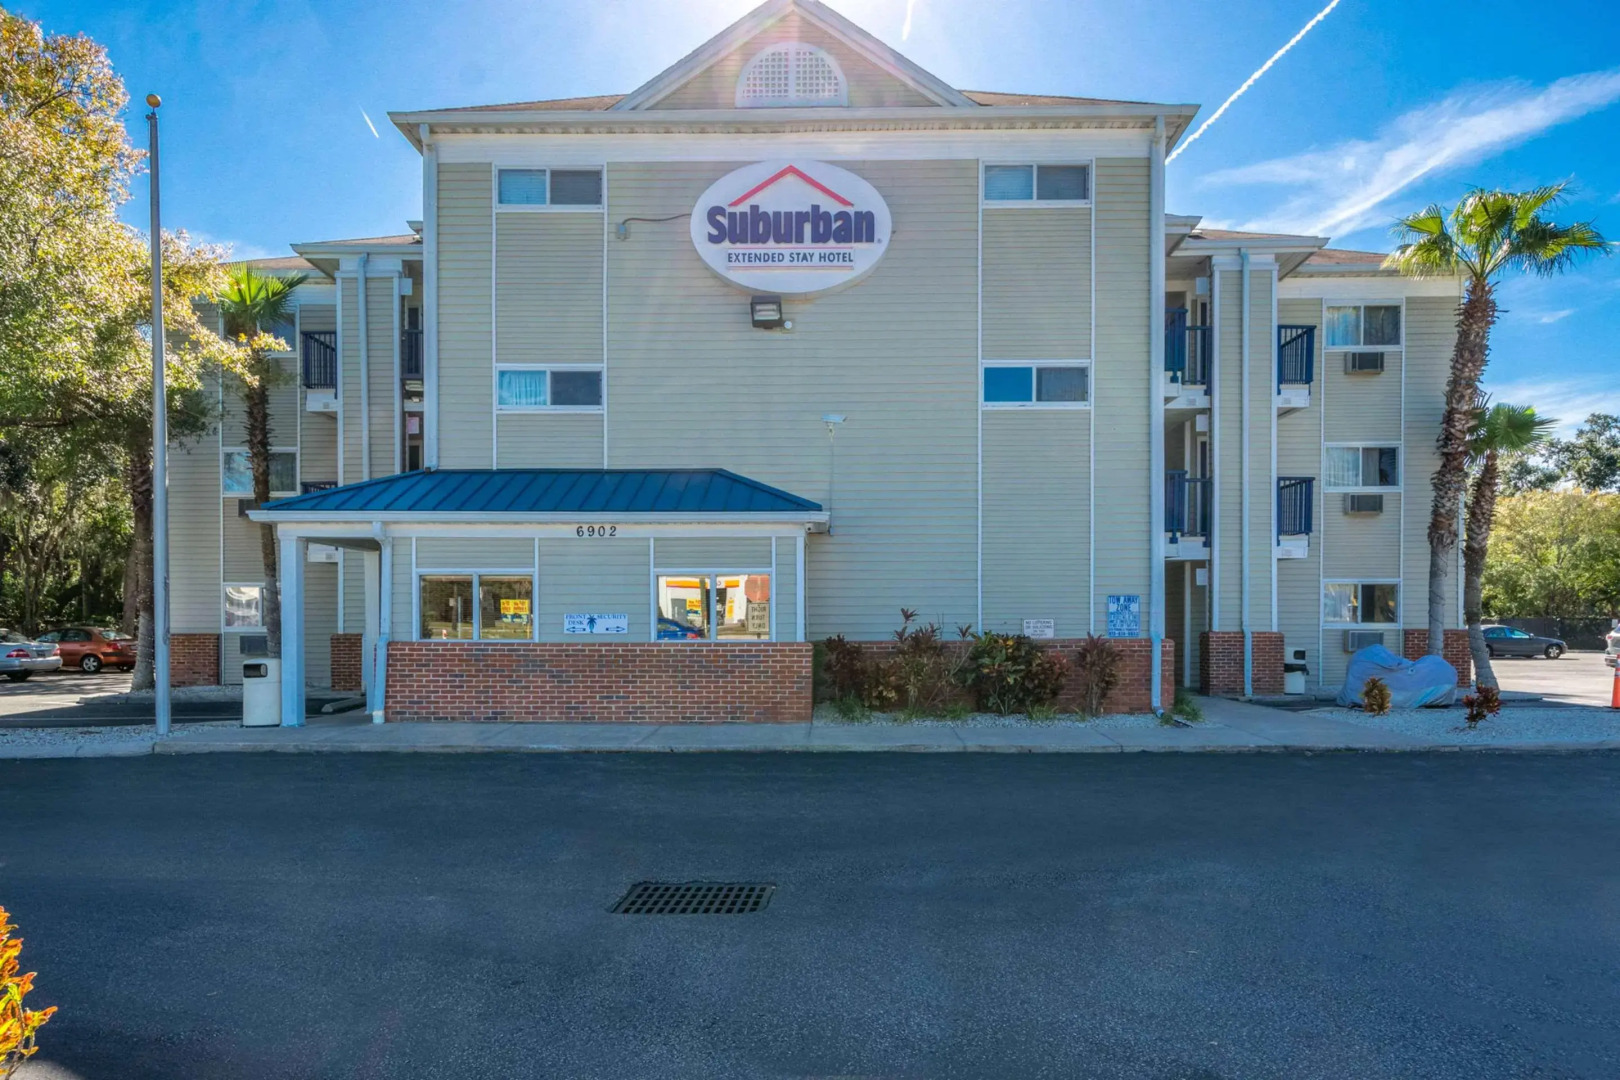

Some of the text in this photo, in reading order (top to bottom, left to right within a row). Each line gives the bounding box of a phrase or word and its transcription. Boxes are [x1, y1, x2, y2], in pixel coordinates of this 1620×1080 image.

[707, 204, 875, 245] Suburban
[728, 252, 854, 263] EXTENDED STAY HOTEL
[576, 525, 617, 538] 6902
[1109, 596, 1138, 604] TOW AWAY
[1116, 603, 1132, 612] ZONE
